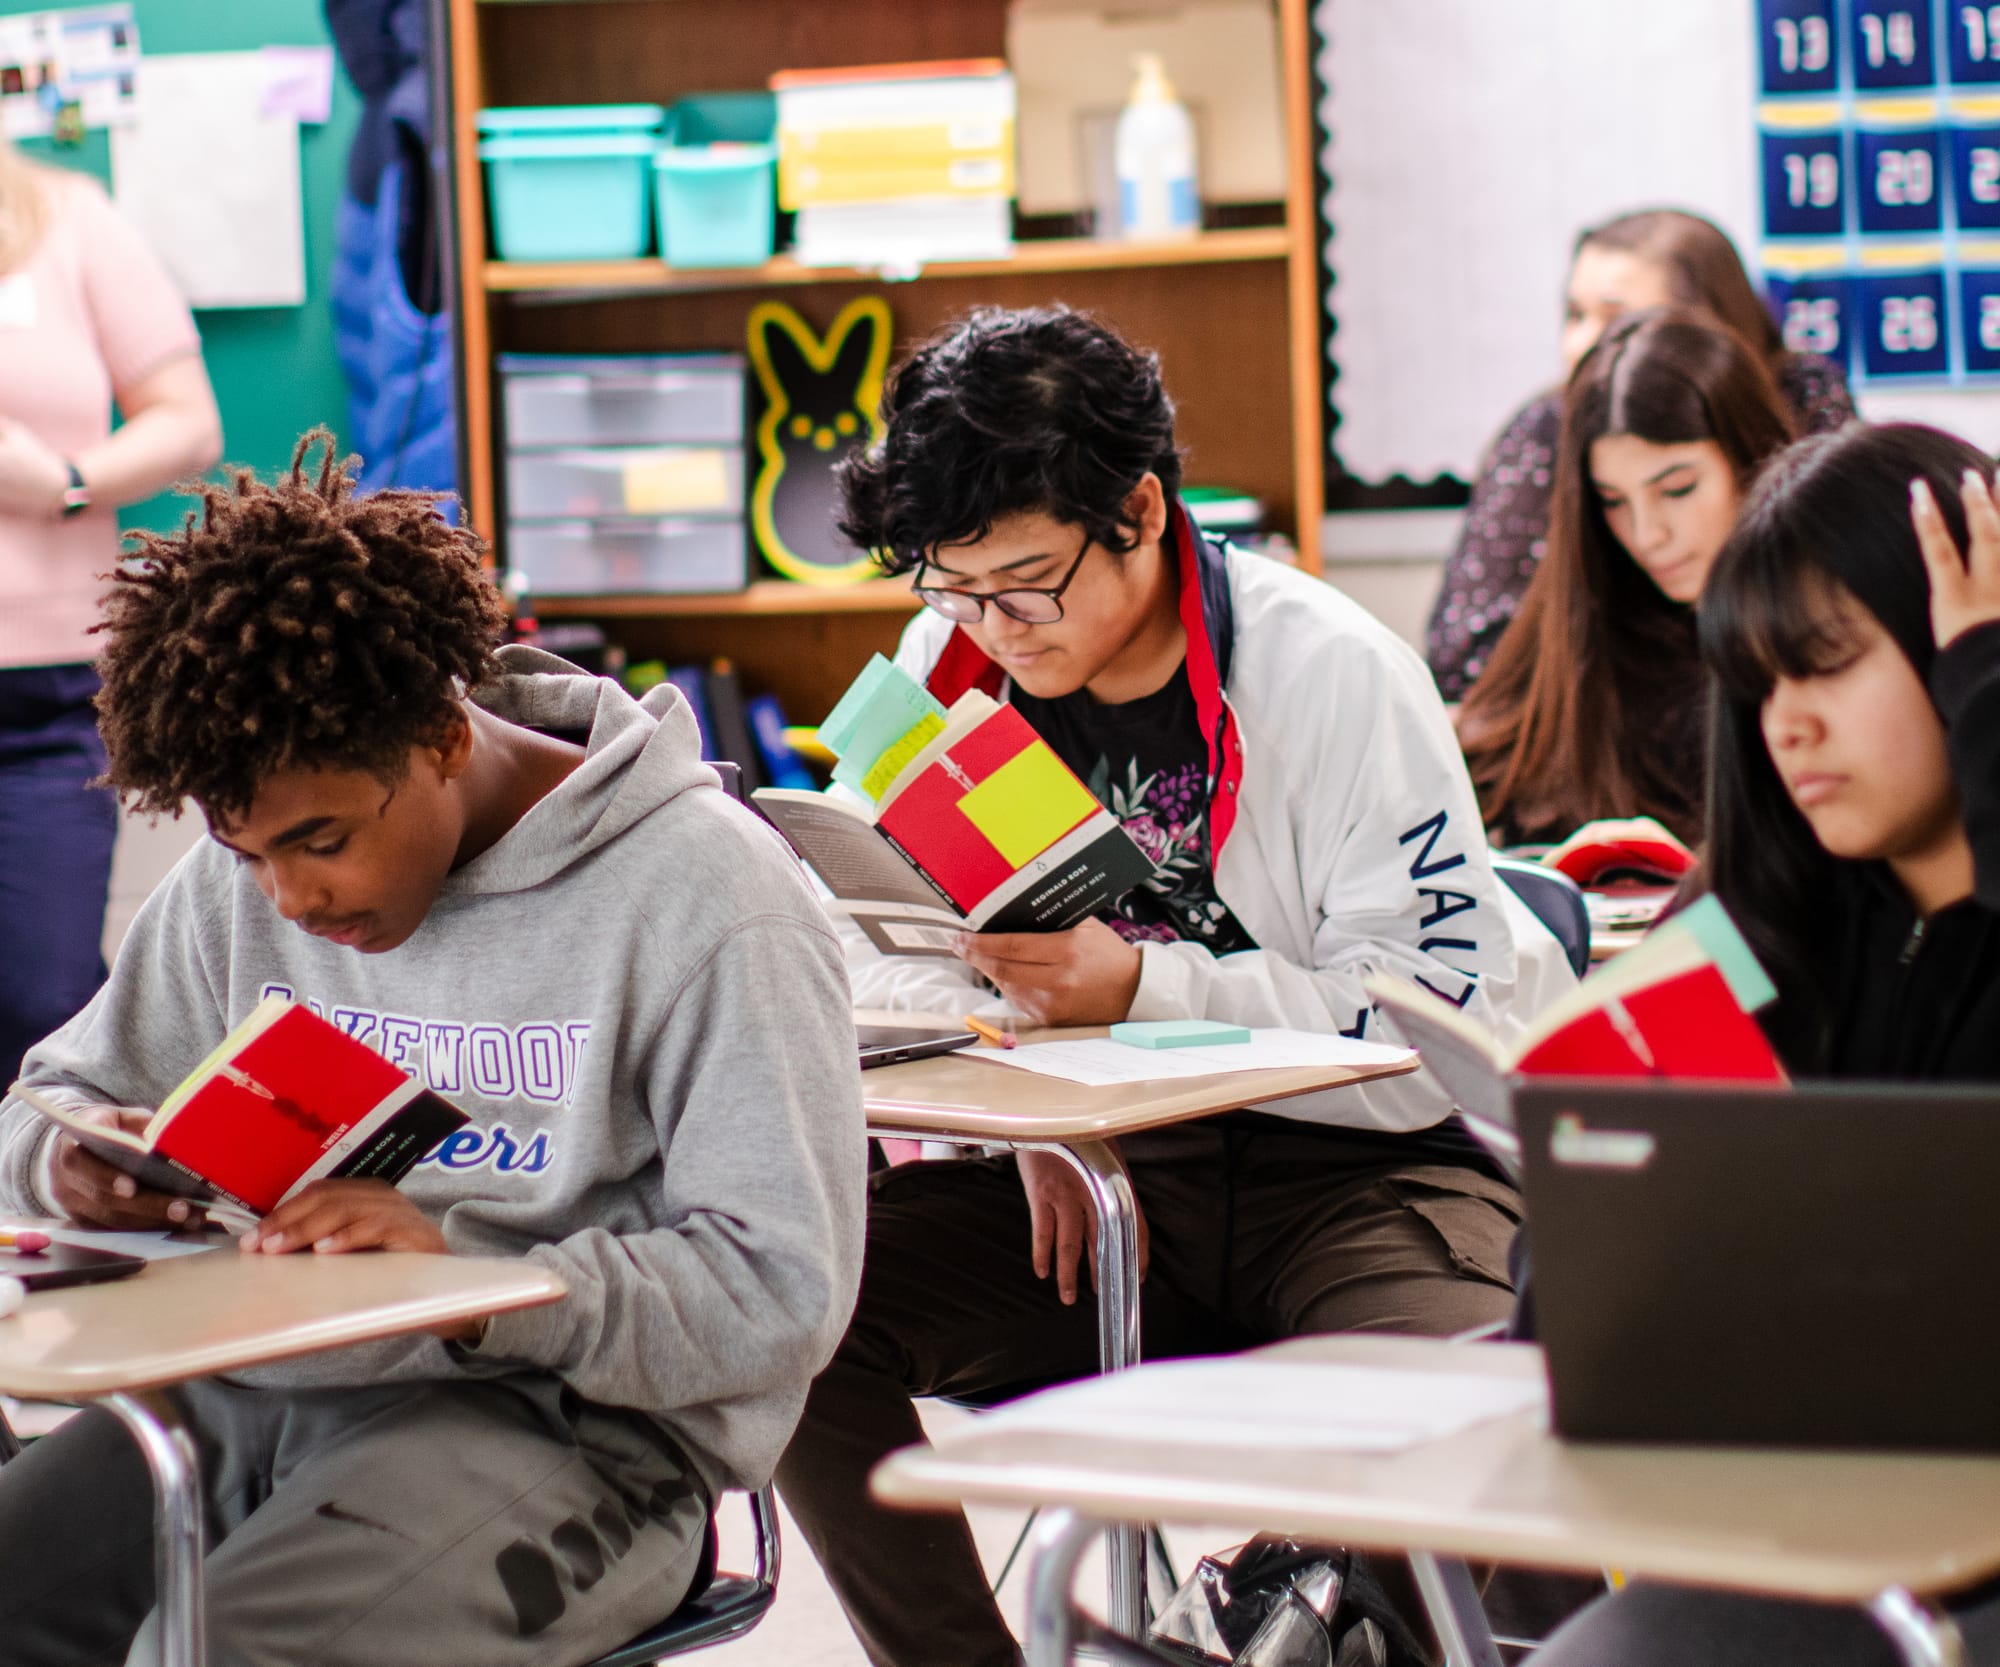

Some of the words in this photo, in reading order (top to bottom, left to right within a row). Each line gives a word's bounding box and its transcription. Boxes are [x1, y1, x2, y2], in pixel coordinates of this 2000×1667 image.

[1775, 15, 1829, 73] 13
[1860, 12, 1915, 68] 14
[1784, 152, 1839, 208] 19
[1876, 149, 1934, 206] 20
[1970, 147, 2000, 204] 2
[1783, 297, 1840, 355] 25
[1881, 295, 1938, 353] 26
[1980, 294, 2000, 351] 2
[1030, 879, 1068, 907] REGINALD
[1067, 864, 1089, 881] ROSE
[1035, 902, 1062, 922] TWELVE
[1063, 883, 1088, 904] ANGRY
[1088, 871, 1107, 887] MEN
[320, 1122, 350, 1150] TWELVE
[345, 1151, 375, 1179] GINALD
[374, 1132, 396, 1152] ROSE
[416, 1126, 553, 1173] ers
